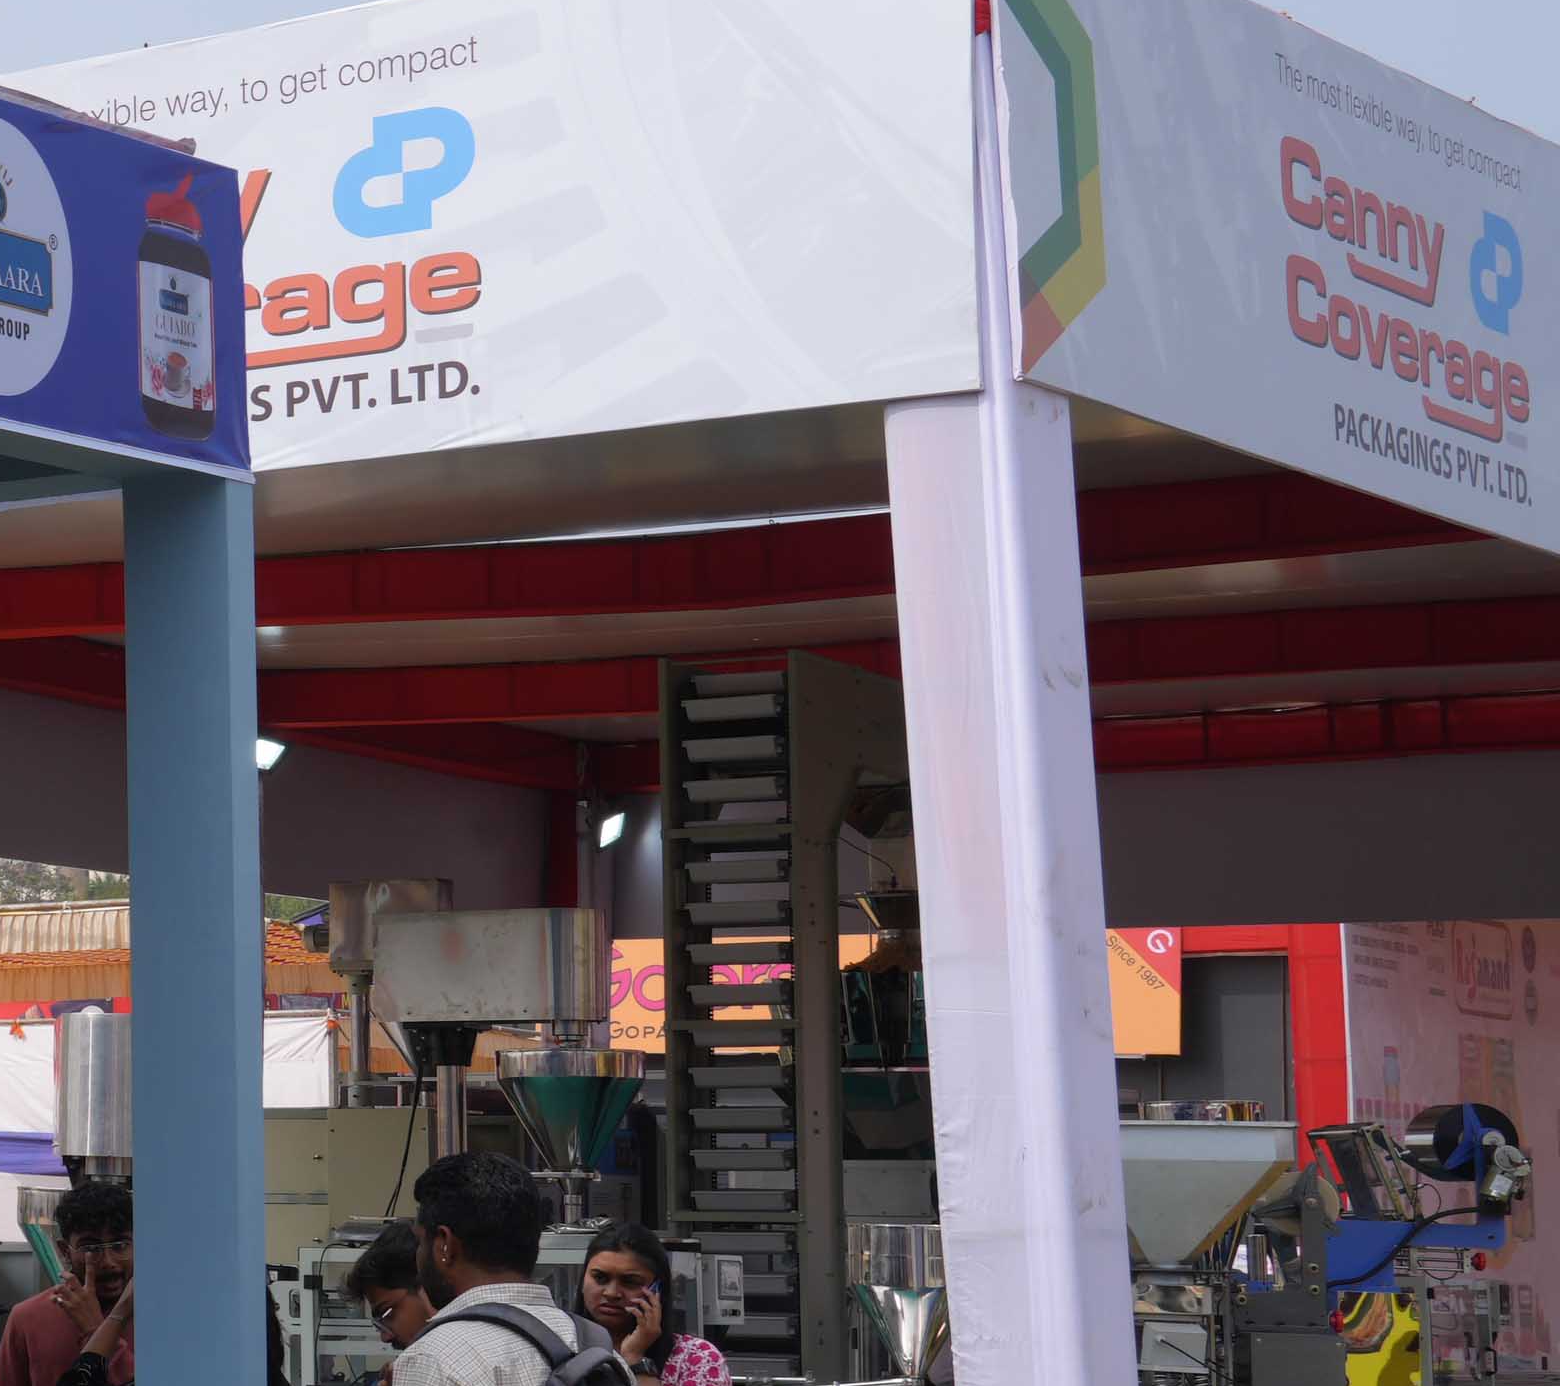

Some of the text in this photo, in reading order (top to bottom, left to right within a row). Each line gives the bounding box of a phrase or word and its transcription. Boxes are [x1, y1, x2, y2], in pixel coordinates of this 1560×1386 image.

[90, 35, 478, 127] xible way, to get compact
[1275, 52, 1303, 93] The
[1307, 73, 1342, 111] most
[1345, 86, 1393, 134] flexible
[1396, 114, 1424, 153] way,
[1428, 128, 1441, 153] to
[1445, 136, 1466, 169] get
[1280, 135, 1445, 308] Canny
[286, 371, 377, 419] PVT.
[390, 359, 481, 406] LTD.
[1285, 253, 1530, 444] Coverage
[1334, 402, 1533, 507] PACKAGINGS PVT. LTD.
[1134, 957, 1166, 992] 1987
